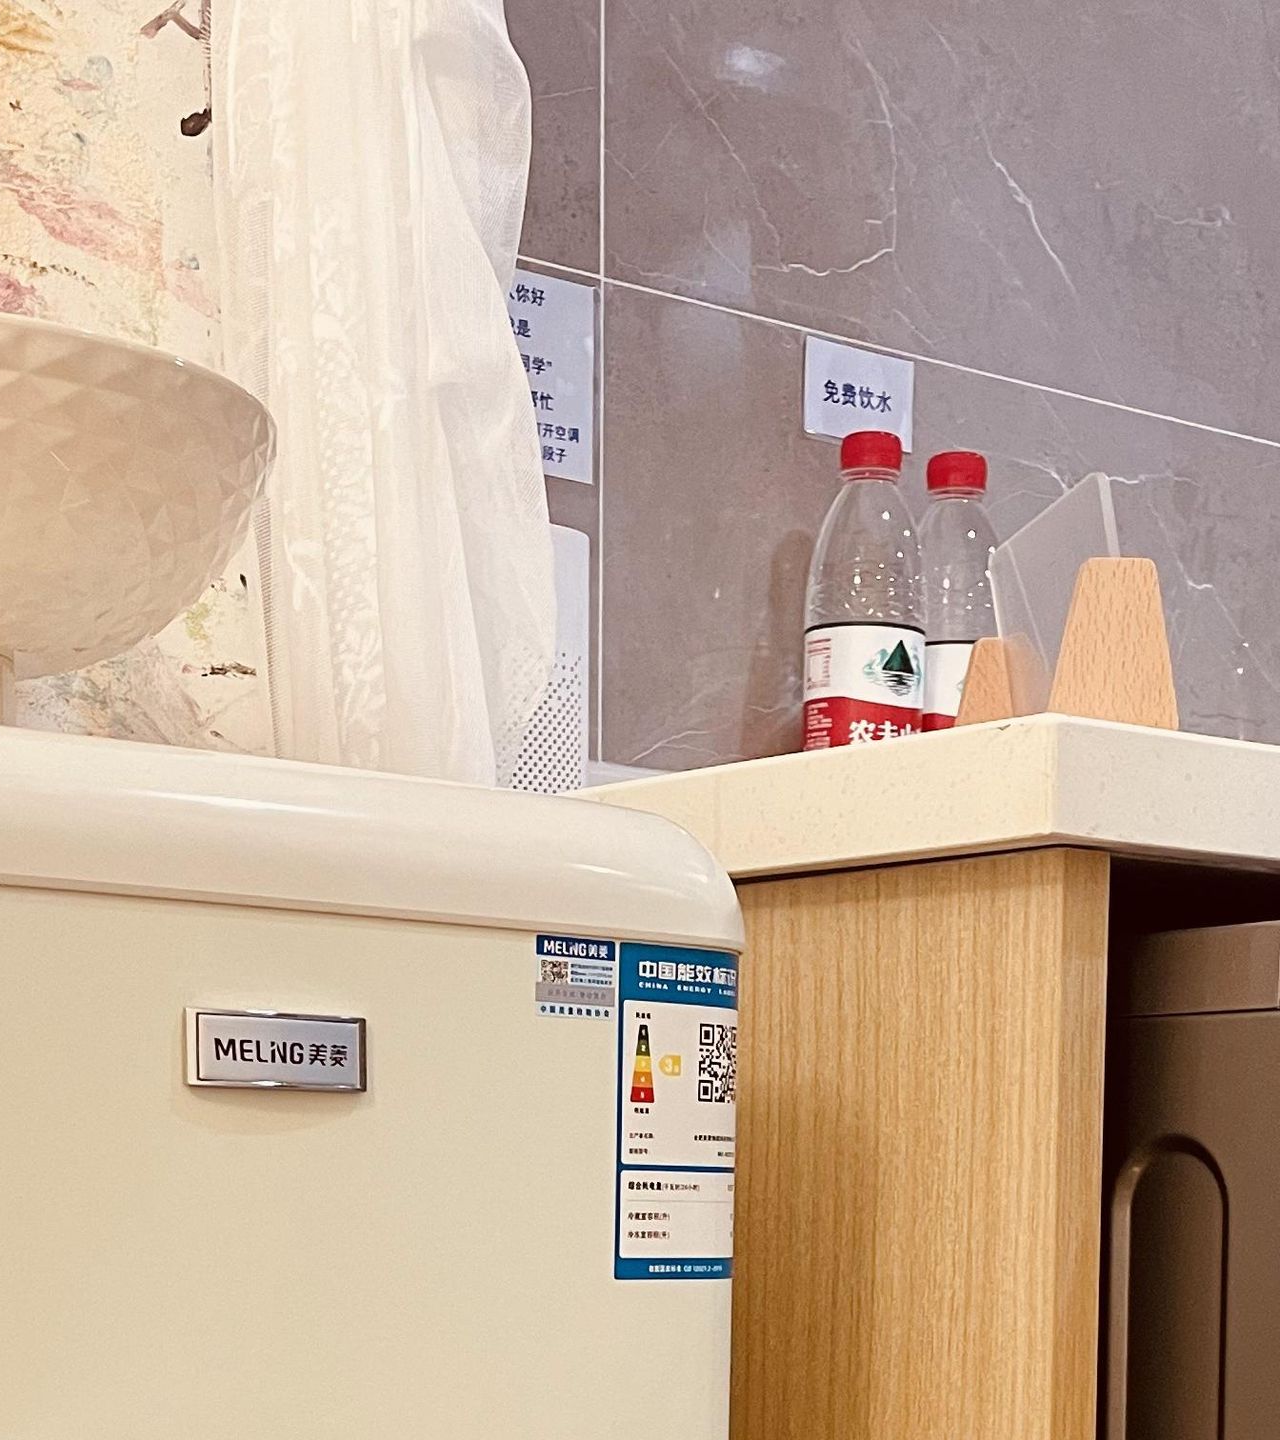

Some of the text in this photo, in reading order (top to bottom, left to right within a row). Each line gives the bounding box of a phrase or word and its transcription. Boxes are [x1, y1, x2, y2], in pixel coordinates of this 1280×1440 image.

[509, 283, 546, 307] 你好
[823, 379, 893, 414] 免费饮水
[848, 719, 921, 744] 农夫山
[638, 960, 737, 986] 中国能效标识
[638, 981, 669, 990] CHINA
[677, 984, 712, 994] ENERGY
